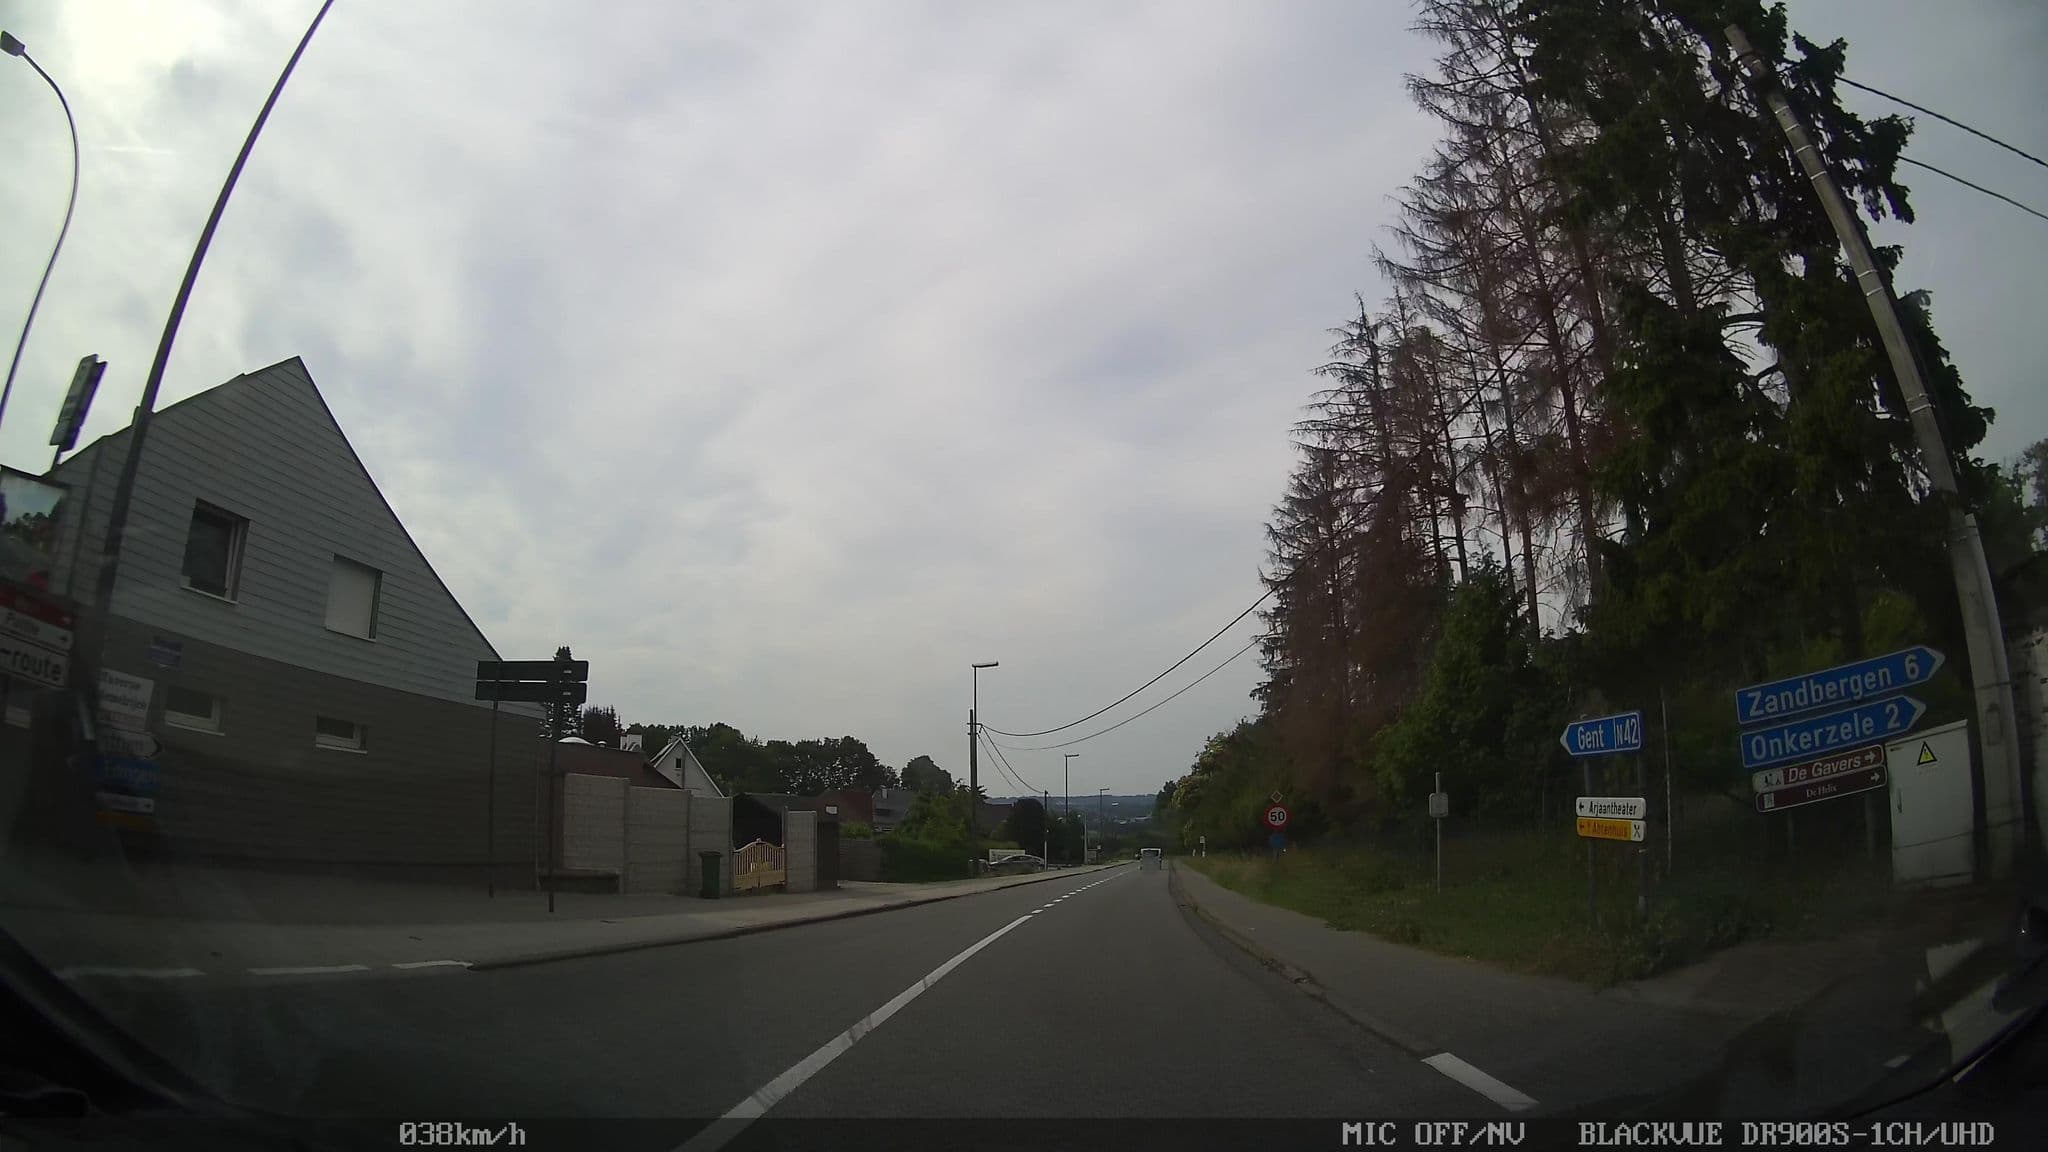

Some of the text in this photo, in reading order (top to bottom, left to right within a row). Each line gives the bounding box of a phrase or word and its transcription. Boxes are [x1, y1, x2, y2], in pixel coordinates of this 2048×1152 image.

[1747, 654, 1920, 717] Zandbergen 6
[1577, 718, 1639, 750] Gent N42
[1751, 703, 1901, 761] Onkerzele 2
[1787, 755, 1861, 784] De Gavers
[1270, 811, 1285, 822] 50
[1588, 800, 1637, 816] Arjaantheater
